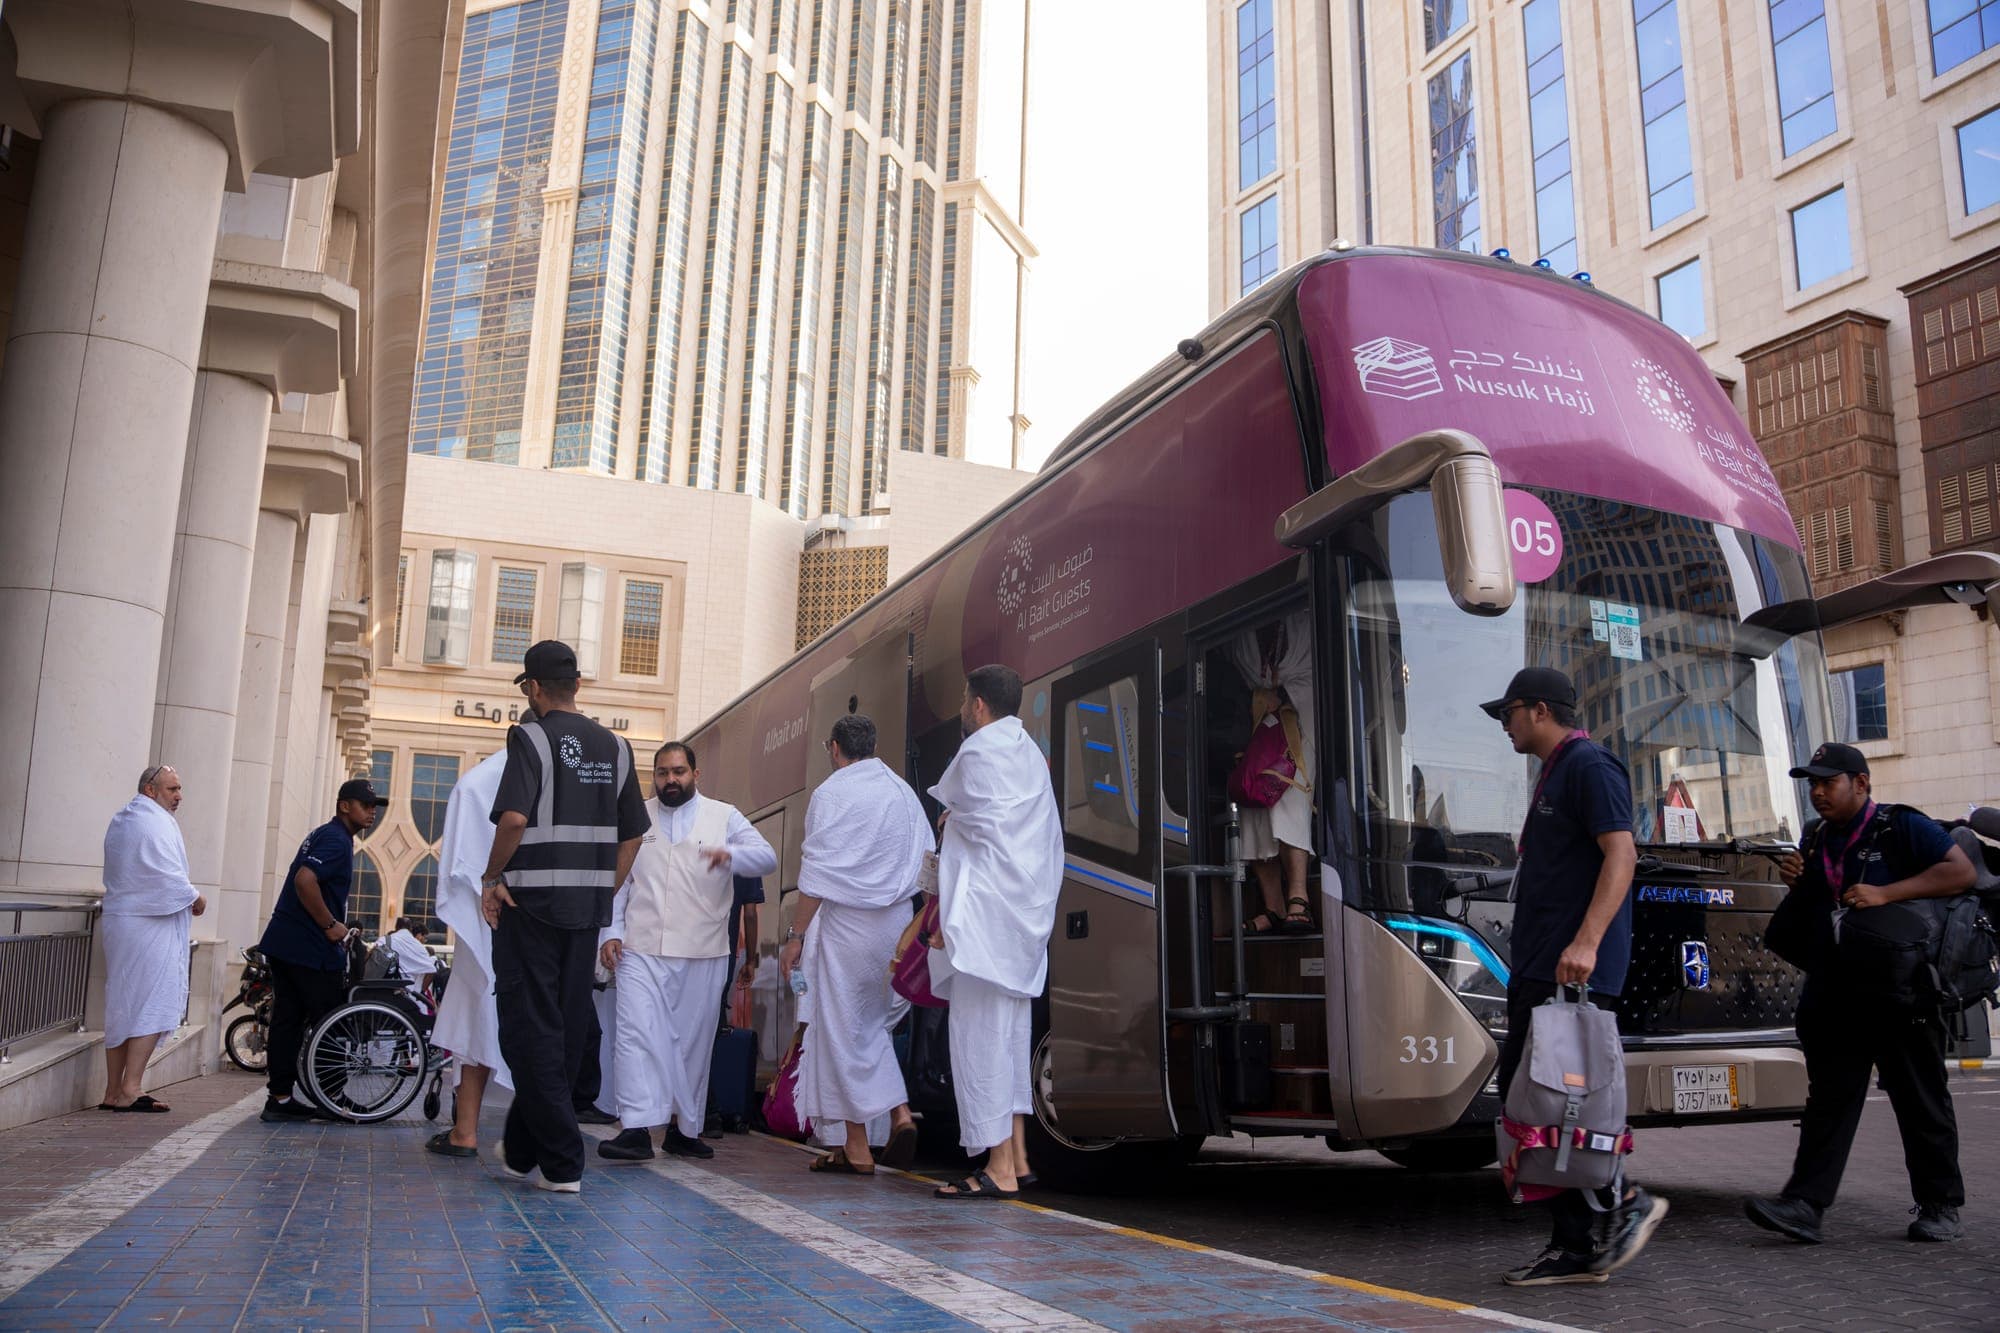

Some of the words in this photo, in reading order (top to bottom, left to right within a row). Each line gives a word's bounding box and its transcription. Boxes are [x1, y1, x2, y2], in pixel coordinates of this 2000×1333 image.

[1449, 349, 1505, 371] حج
[1453, 373, 1540, 401] Nusuk
[1543, 384, 1596, 416] Hajj
[1696, 441, 1715, 463] Al
[1714, 447, 1749, 478] Bait
[1510, 517, 1556, 556] 05
[1057, 543, 1094, 578] ضيوف
[1031, 563, 1056, 595] البيت
[1016, 611, 1027, 633] Al
[1029, 599, 1051, 627] Bait
[1052, 577, 1092, 613] Guests
[454, 699, 502, 724] مكة
[582, 769, 593, 777] Bait
[593, 769, 613, 777] Guests
[1638, 885, 1735, 905] ASIASTAR
[1399, 1035, 1457, 1064] 331
[1678, 1091, 1705, 1111] 3757
[1709, 1093, 1730, 1106] HXA
